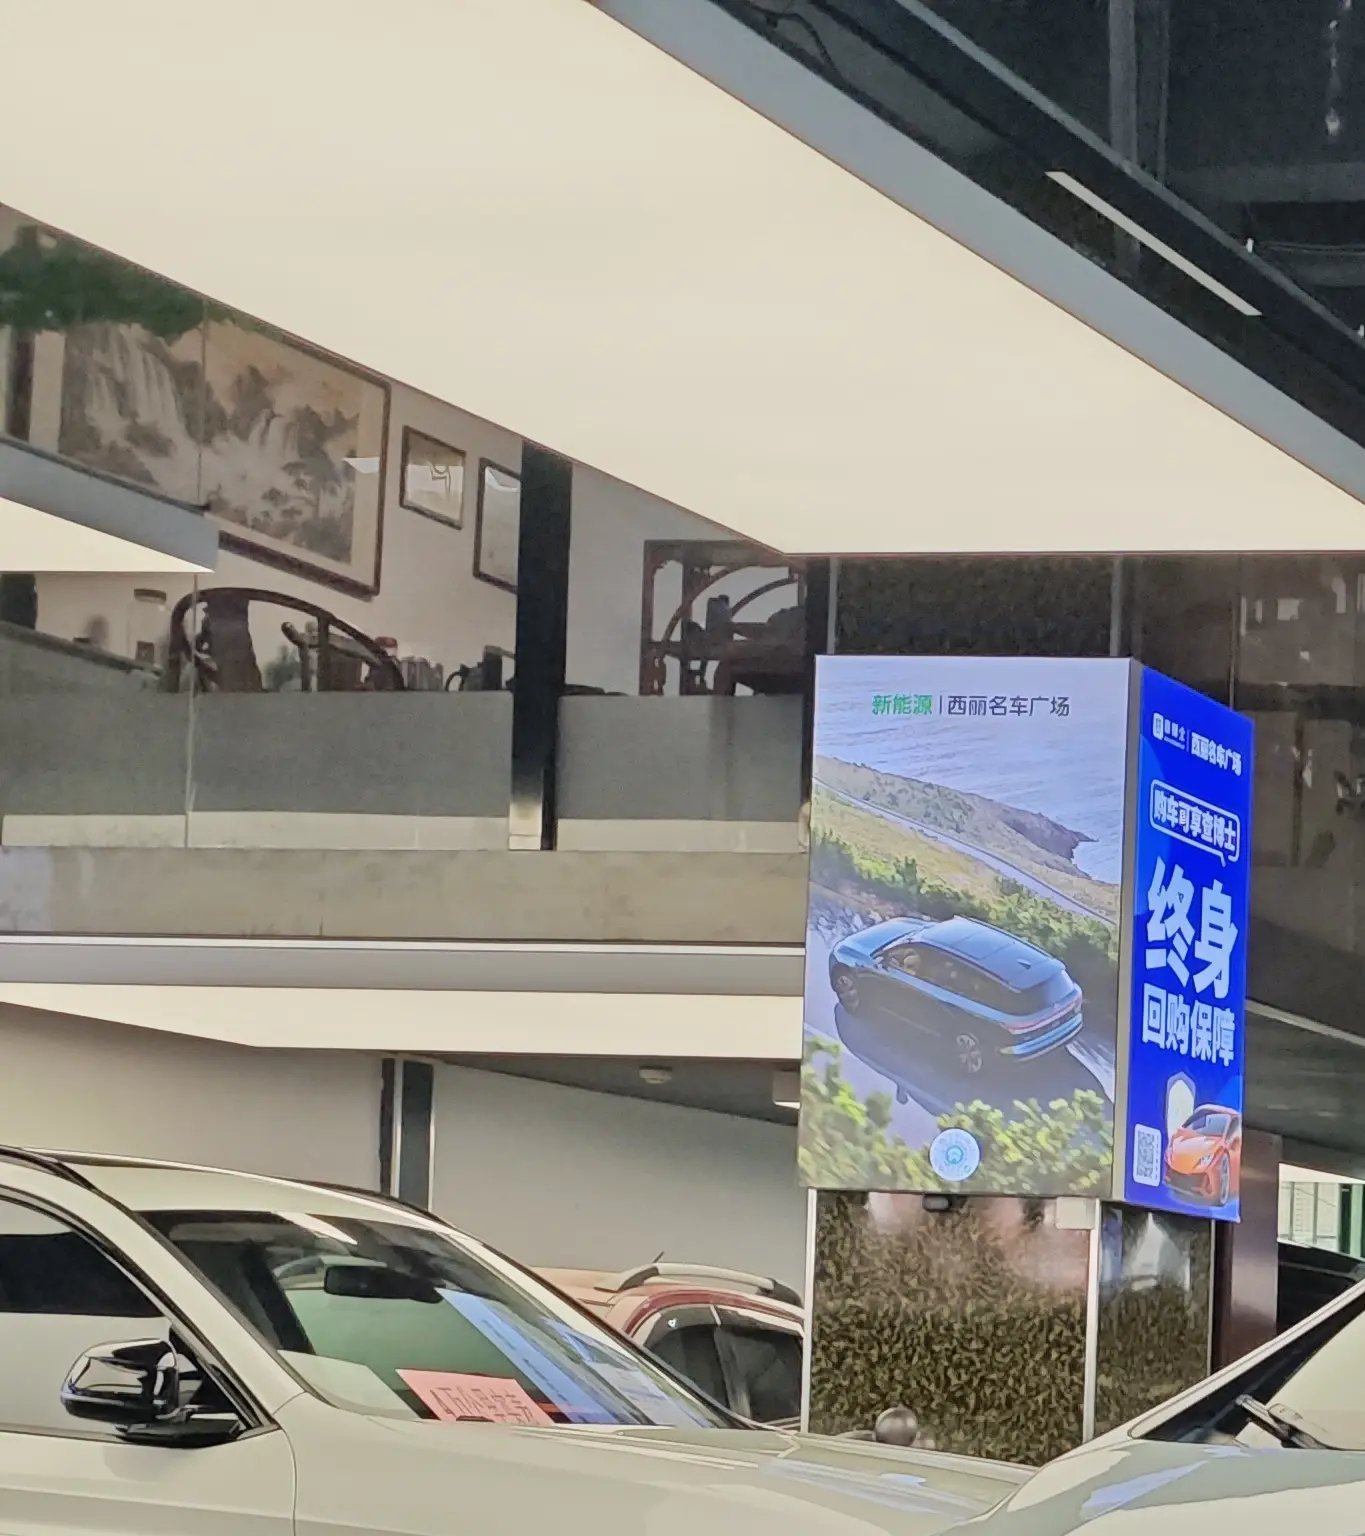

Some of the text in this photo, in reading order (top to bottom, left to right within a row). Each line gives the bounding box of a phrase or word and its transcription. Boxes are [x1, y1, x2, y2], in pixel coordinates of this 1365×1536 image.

[872, 694, 1070, 717] 新能源 西丽名车广场
[1145, 856, 1238, 999] 终身
[1142, 982, 1235, 1067] 回购保障
